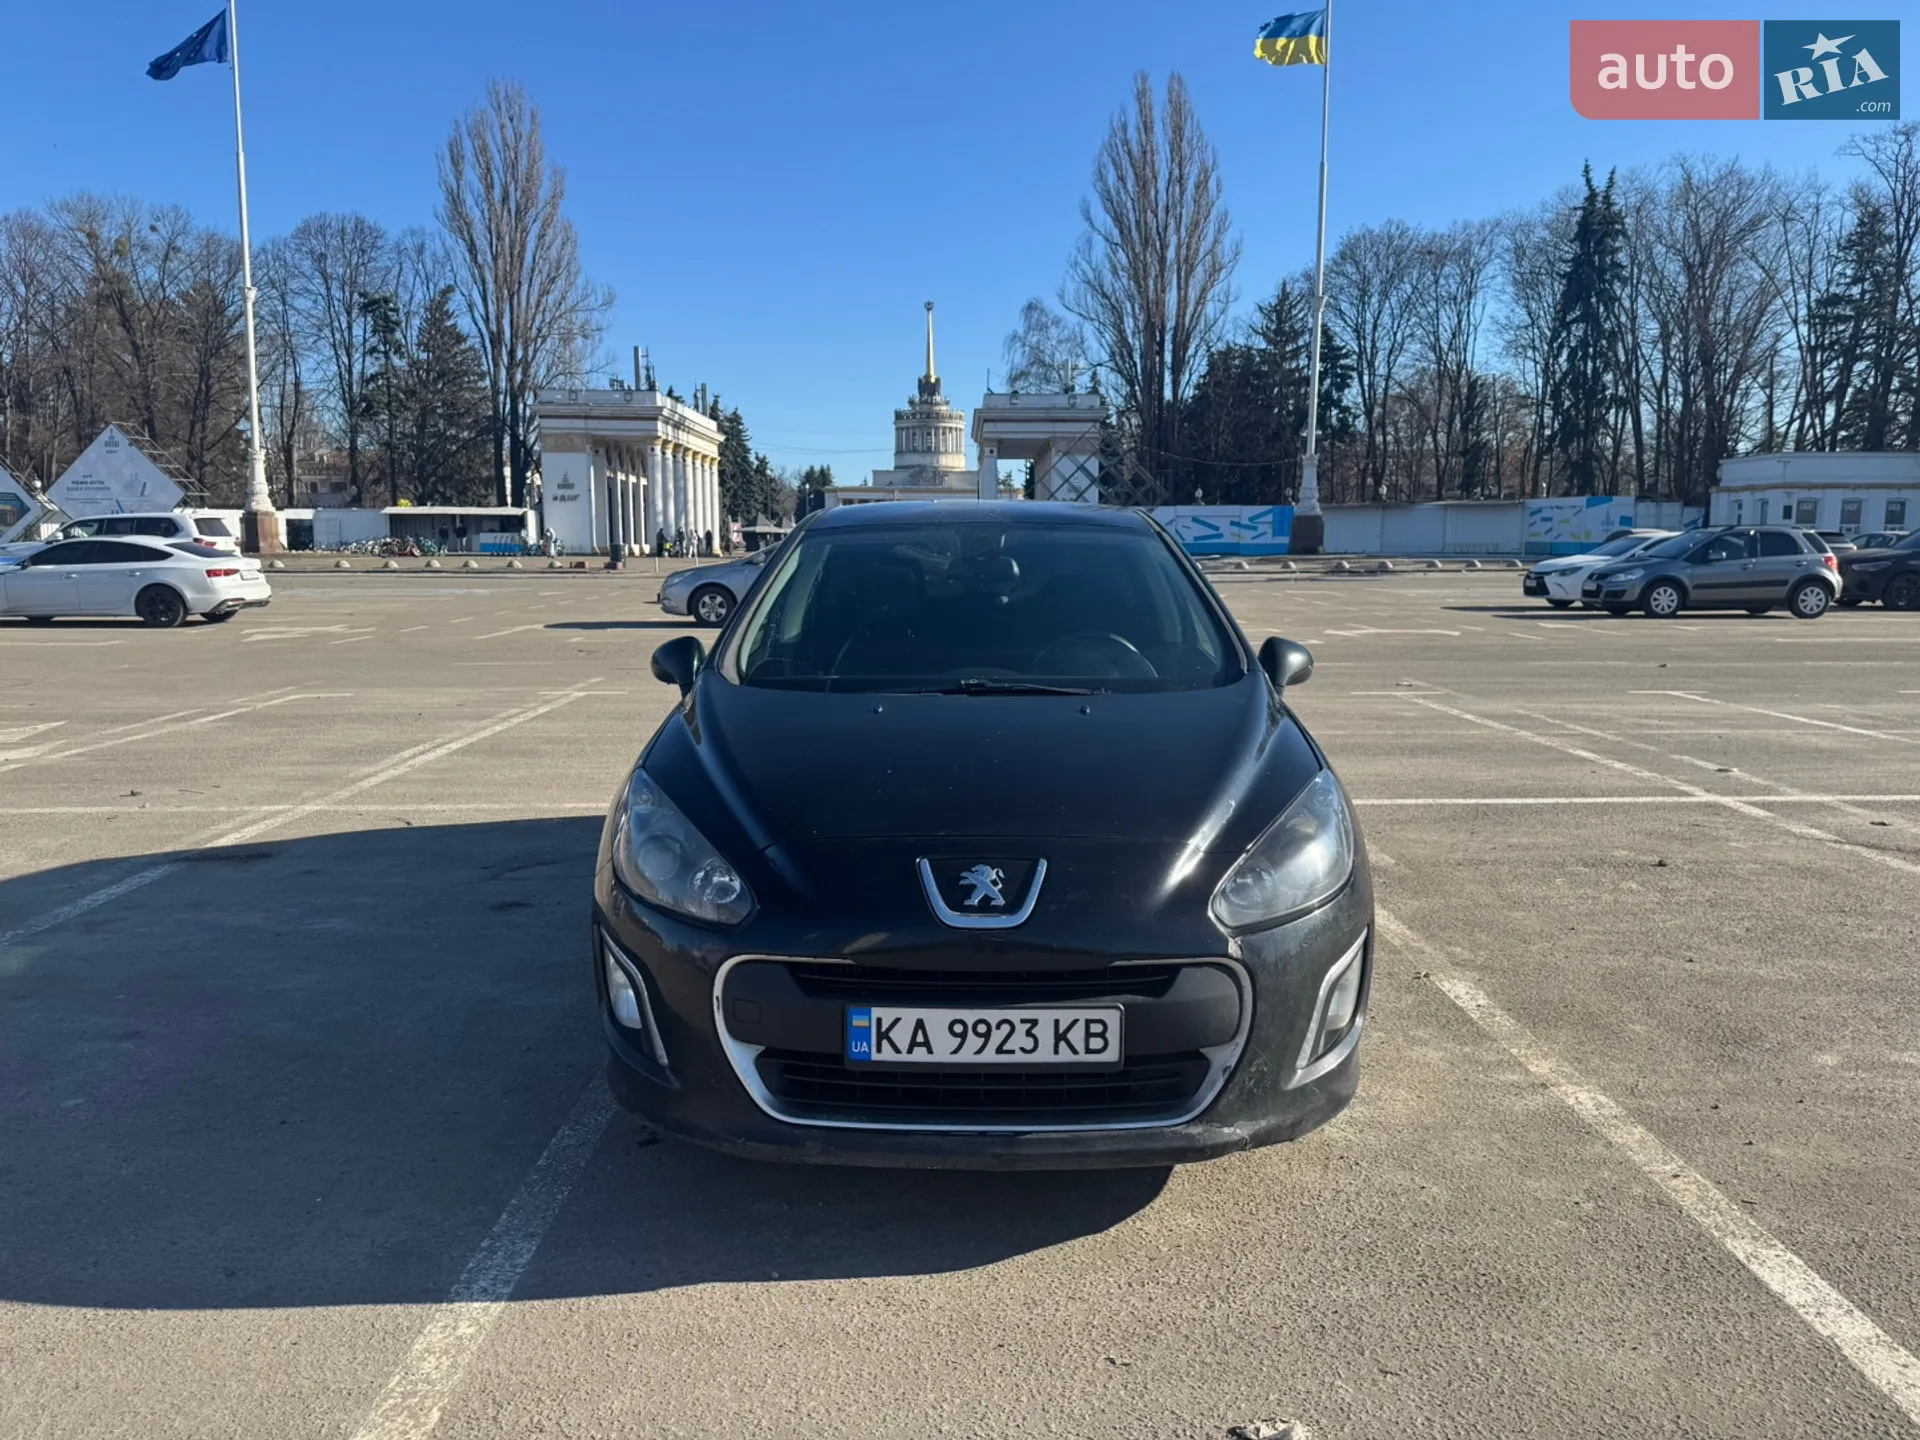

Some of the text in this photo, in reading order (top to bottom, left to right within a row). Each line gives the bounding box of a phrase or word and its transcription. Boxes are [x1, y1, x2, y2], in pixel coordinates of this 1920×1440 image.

[852, 1041, 869, 1053] UA
[875, 1016, 1109, 1055] KA 9923 KB
